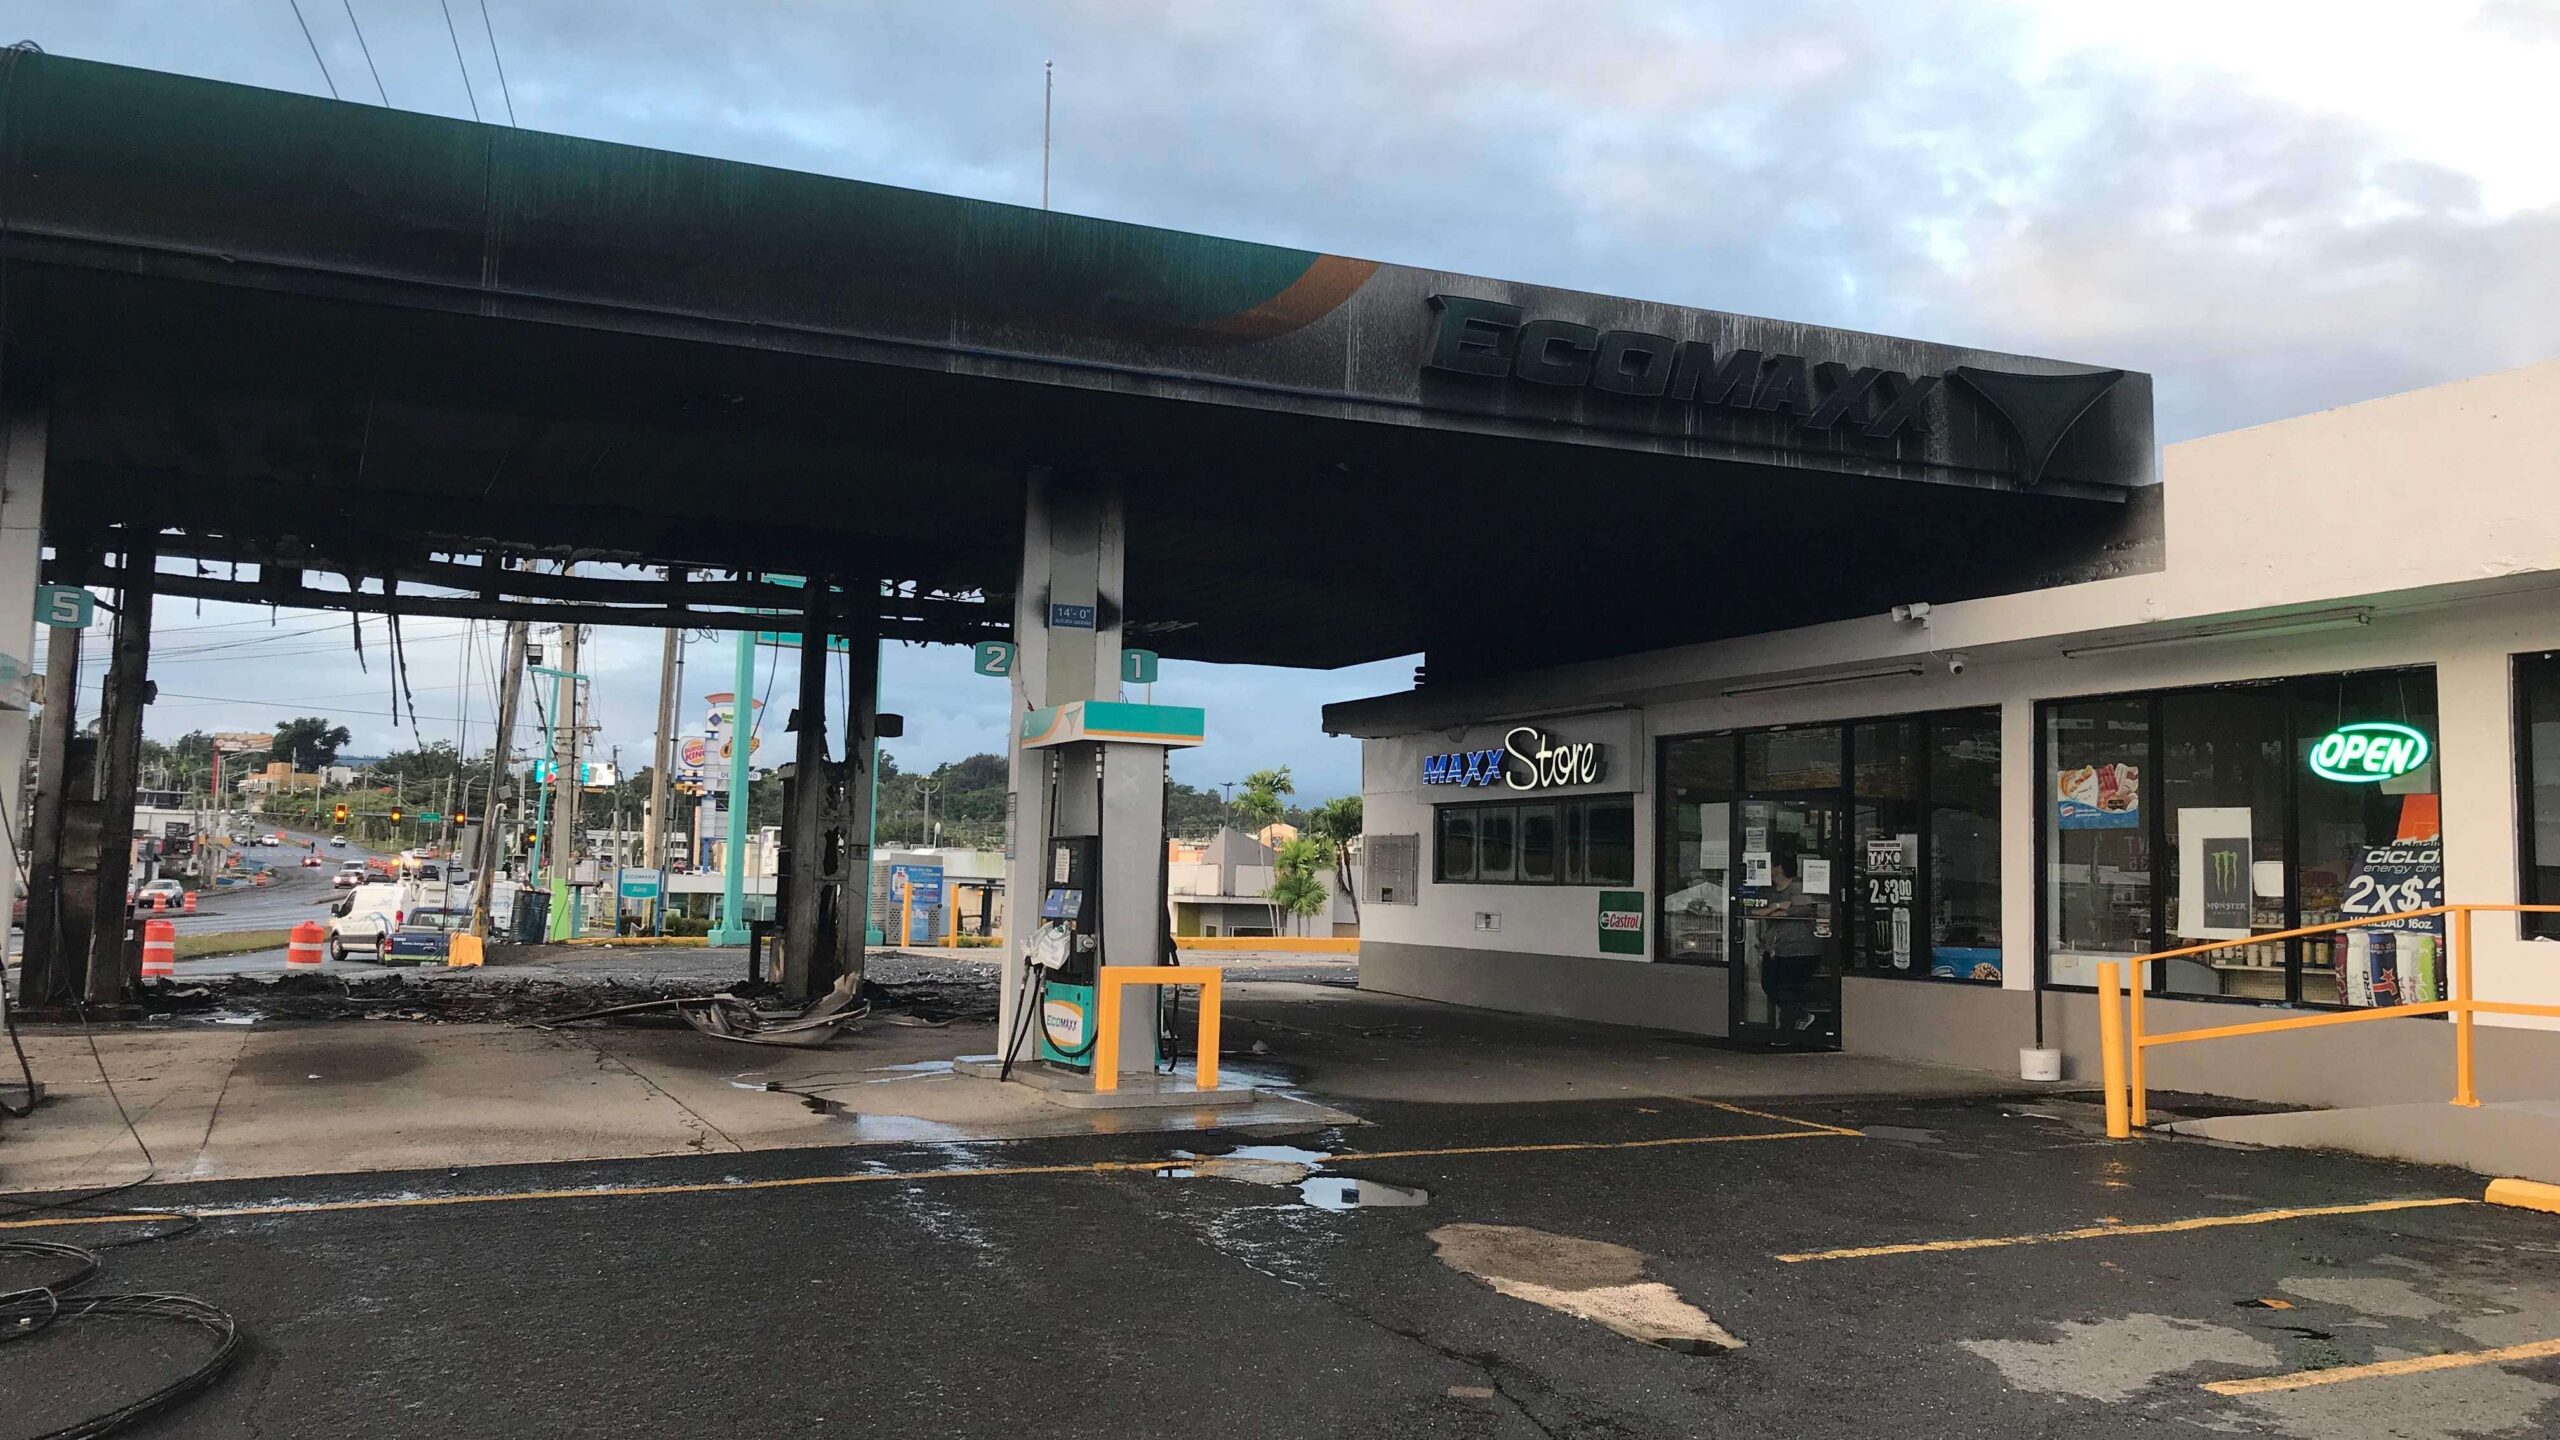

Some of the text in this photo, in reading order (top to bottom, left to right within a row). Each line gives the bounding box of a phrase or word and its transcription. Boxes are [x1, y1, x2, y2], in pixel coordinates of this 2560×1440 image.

[1430, 294, 1941, 438] ECOMAXX
[51, 591, 80, 623] 5
[985, 646, 1006, 672] 2
[1131, 653, 1141, 679] 1
[1023, 721, 1030, 737] 2
[1423, 726, 1598, 791] MAXX Store
[2318, 733, 2415, 775] OPEN
[2366, 848, 2441, 864] CICLO
[2363, 864, 2412, 875] energy
[1869, 879, 1880, 904] 2
[2206, 902, 2247, 911] MONSTER
[1609, 913, 1640, 929] Castrol
[1046, 1014, 1078, 1032] ECOMAXX
